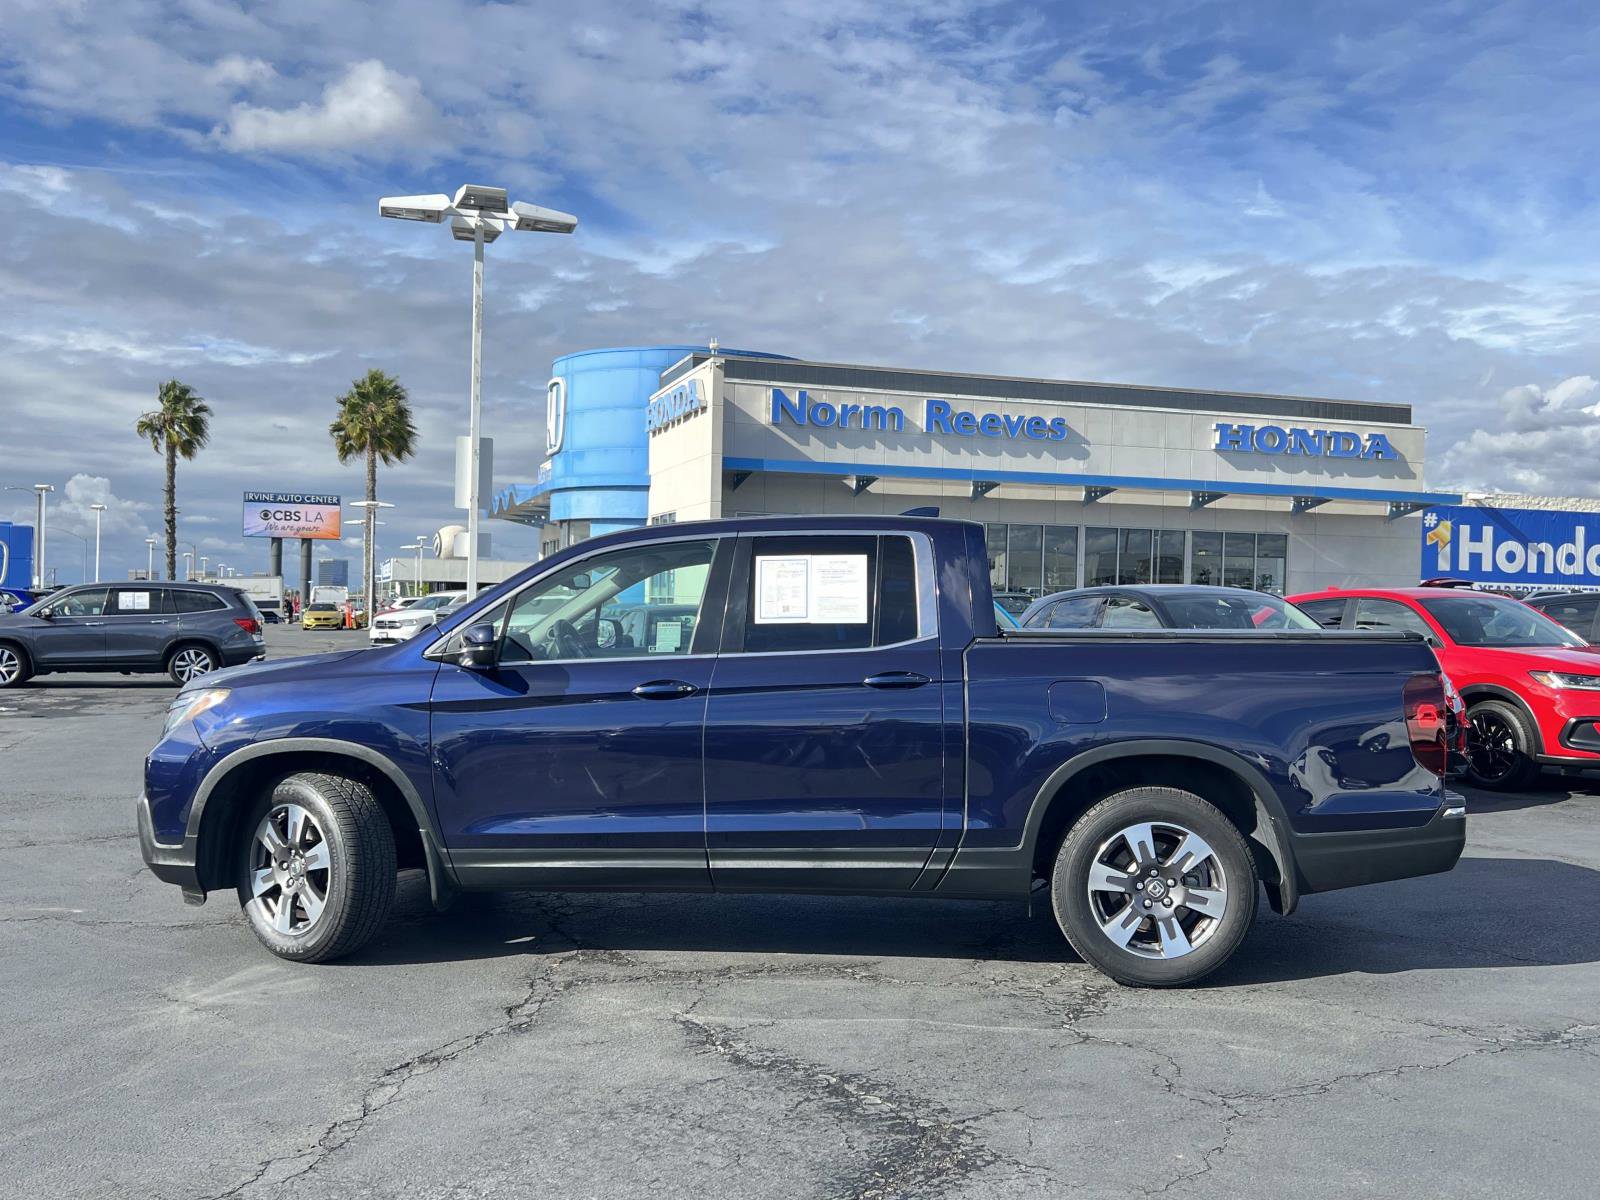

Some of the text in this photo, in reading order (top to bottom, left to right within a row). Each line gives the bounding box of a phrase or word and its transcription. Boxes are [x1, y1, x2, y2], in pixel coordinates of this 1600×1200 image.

[645, 379, 701, 432] HONDA
[770, 388, 1068, 441] Norm Reeves
[1212, 423, 1398, 460] HONDA
[245, 492, 338, 504] IRVINE AUTO CENTER
[264, 521, 279, 531] We
[273, 510, 325, 523] CBS LA
